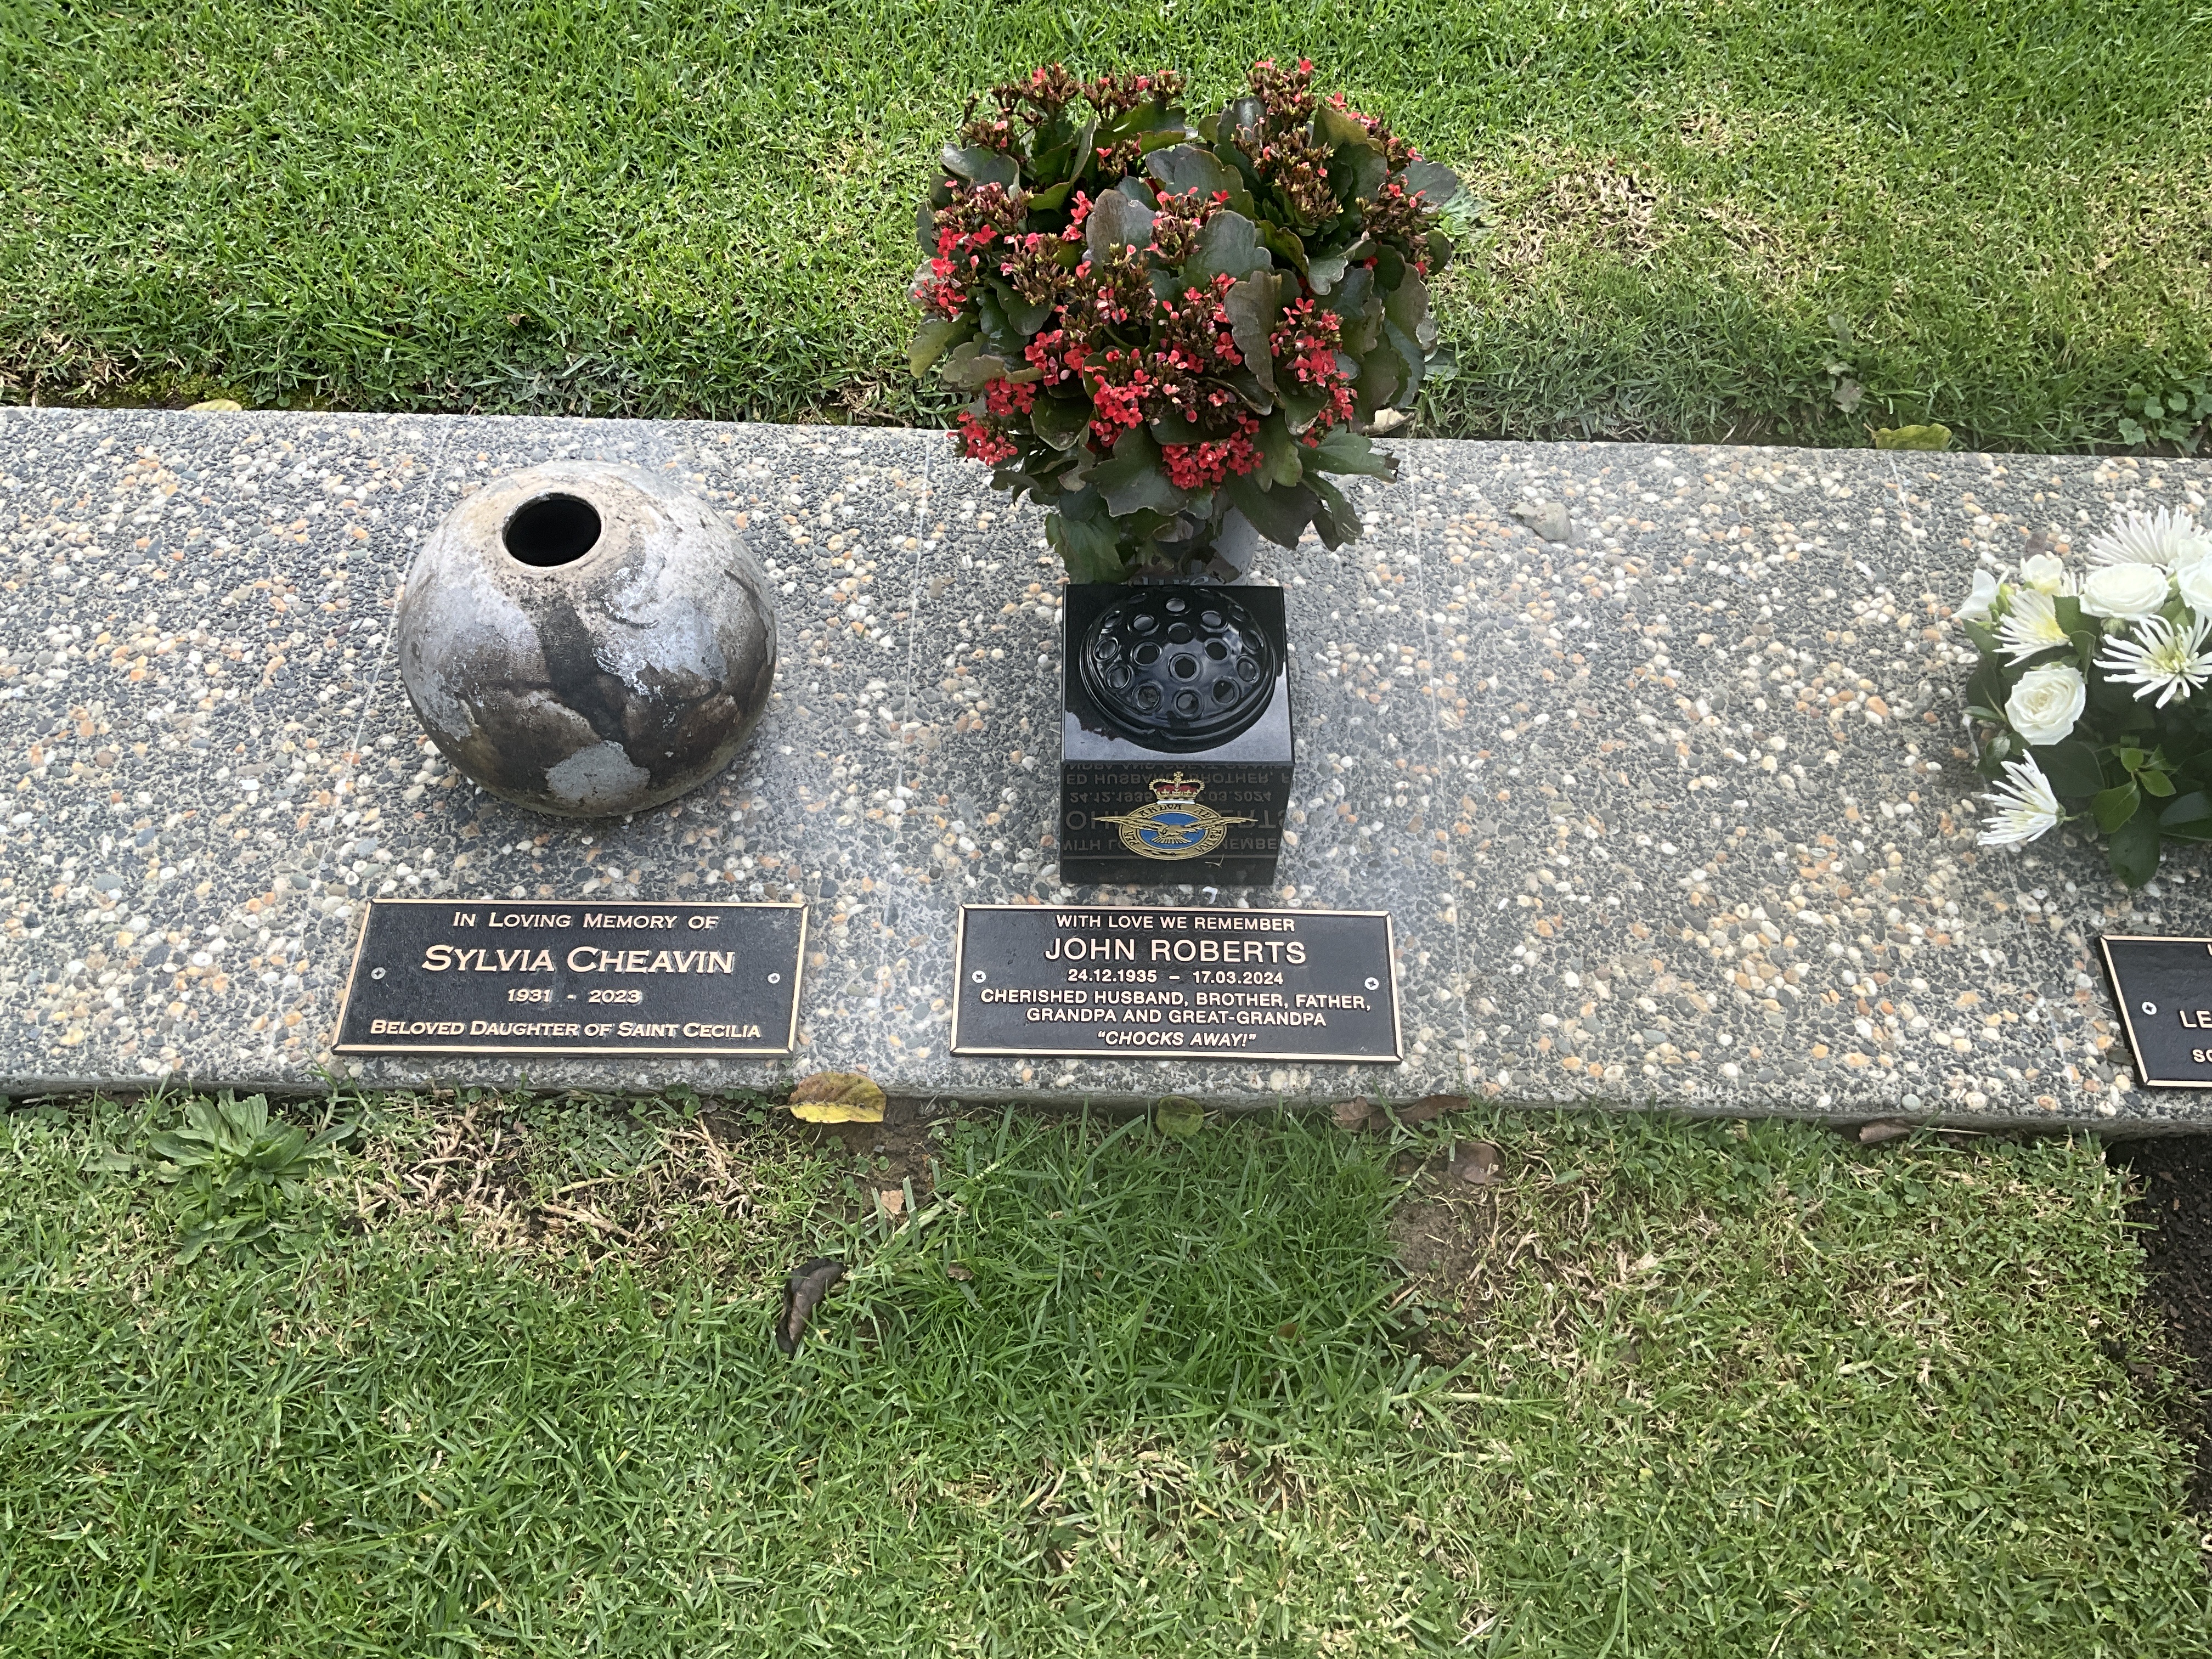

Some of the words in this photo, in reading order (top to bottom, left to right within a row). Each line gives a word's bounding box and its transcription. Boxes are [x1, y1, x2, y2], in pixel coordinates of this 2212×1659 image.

[1056, 915, 1101, 928] WITH
[1108, 915, 1153, 928] LOVE
[1160, 916, 1187, 929] WE
[1194, 917, 1295, 932] REMEMBER
[1045, 938, 1135, 961] JOHN
[1151, 939, 1306, 964] ROBERTS
[1068, 968, 1157, 983] 24.12.1935
[1193, 970, 1284, 985] 17.03.2024
[507, 989, 551, 1002] 1931
[588, 990, 642, 1003] 2023
[980, 989, 1087, 1003] CHERISHED
[1094, 990, 1189, 1007] HUSBAND,
[1196, 992, 1288, 1009] BROTHER,
[1295, 994, 1371, 1011] FATHER,
[1026, 1007, 1117, 1022] GRANDPA
[1122, 1009, 1161, 1023] AND
[1169, 1009, 1327, 1026] GREAT-GRANDPA
